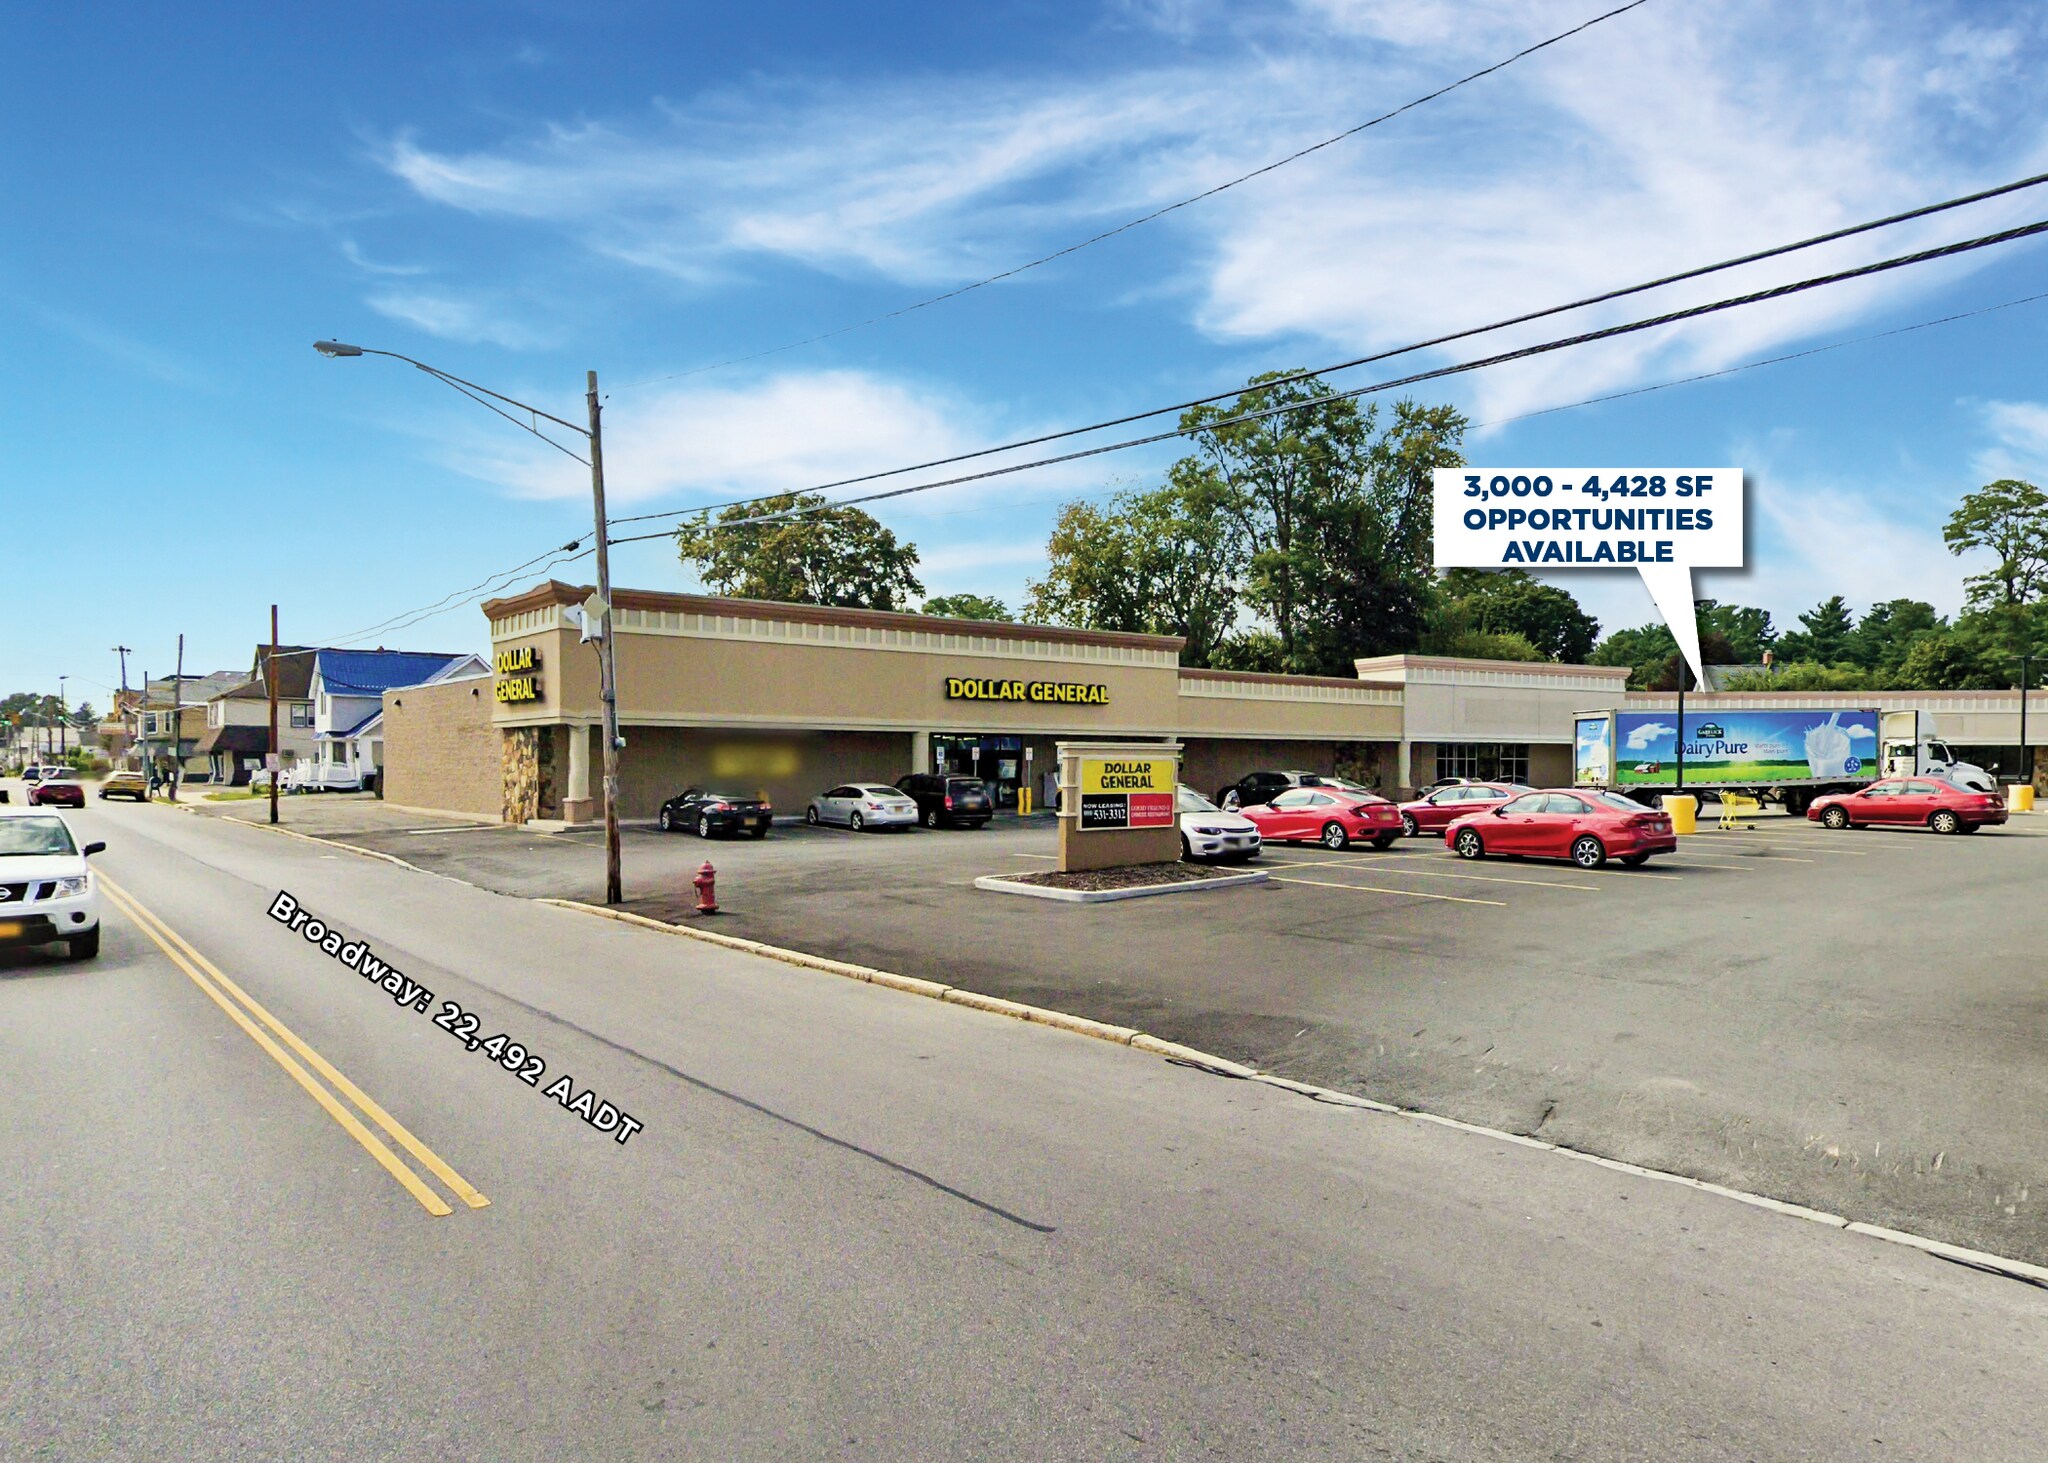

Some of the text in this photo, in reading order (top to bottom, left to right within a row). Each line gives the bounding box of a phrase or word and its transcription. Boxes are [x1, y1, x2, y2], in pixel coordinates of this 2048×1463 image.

[497, 647, 533, 673] DOLLAR
[495, 677, 536, 702] GENERAL
[947, 678, 1109, 704] DOLLAR GENERAL
[1104, 763, 1151, 774] DOLLAR
[1100, 775, 1154, 788] GENERAL
[1093, 809, 1127, 820] 531-3312
